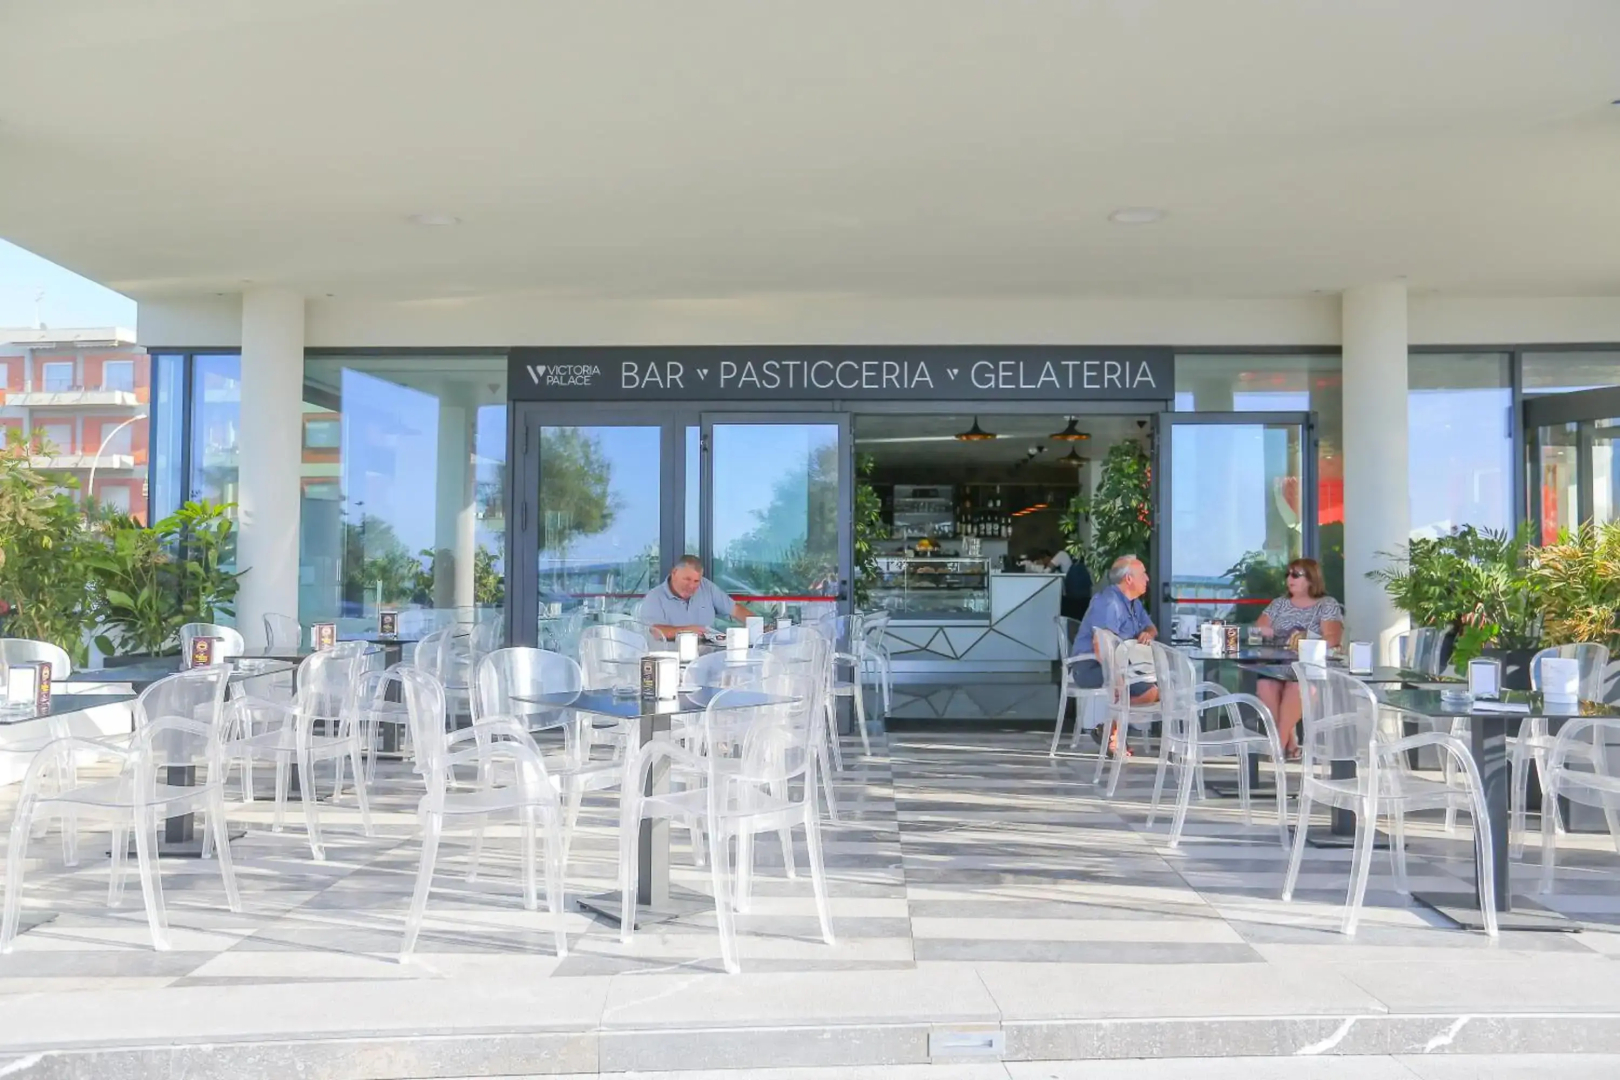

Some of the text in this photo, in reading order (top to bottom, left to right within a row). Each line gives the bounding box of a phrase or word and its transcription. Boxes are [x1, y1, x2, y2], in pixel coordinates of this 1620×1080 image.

[547, 365, 601, 376] VICTORIA
[621, 361, 1157, 389] BAR PASTICCERIA GELATERIA
[546, 375, 592, 386] PALACE
